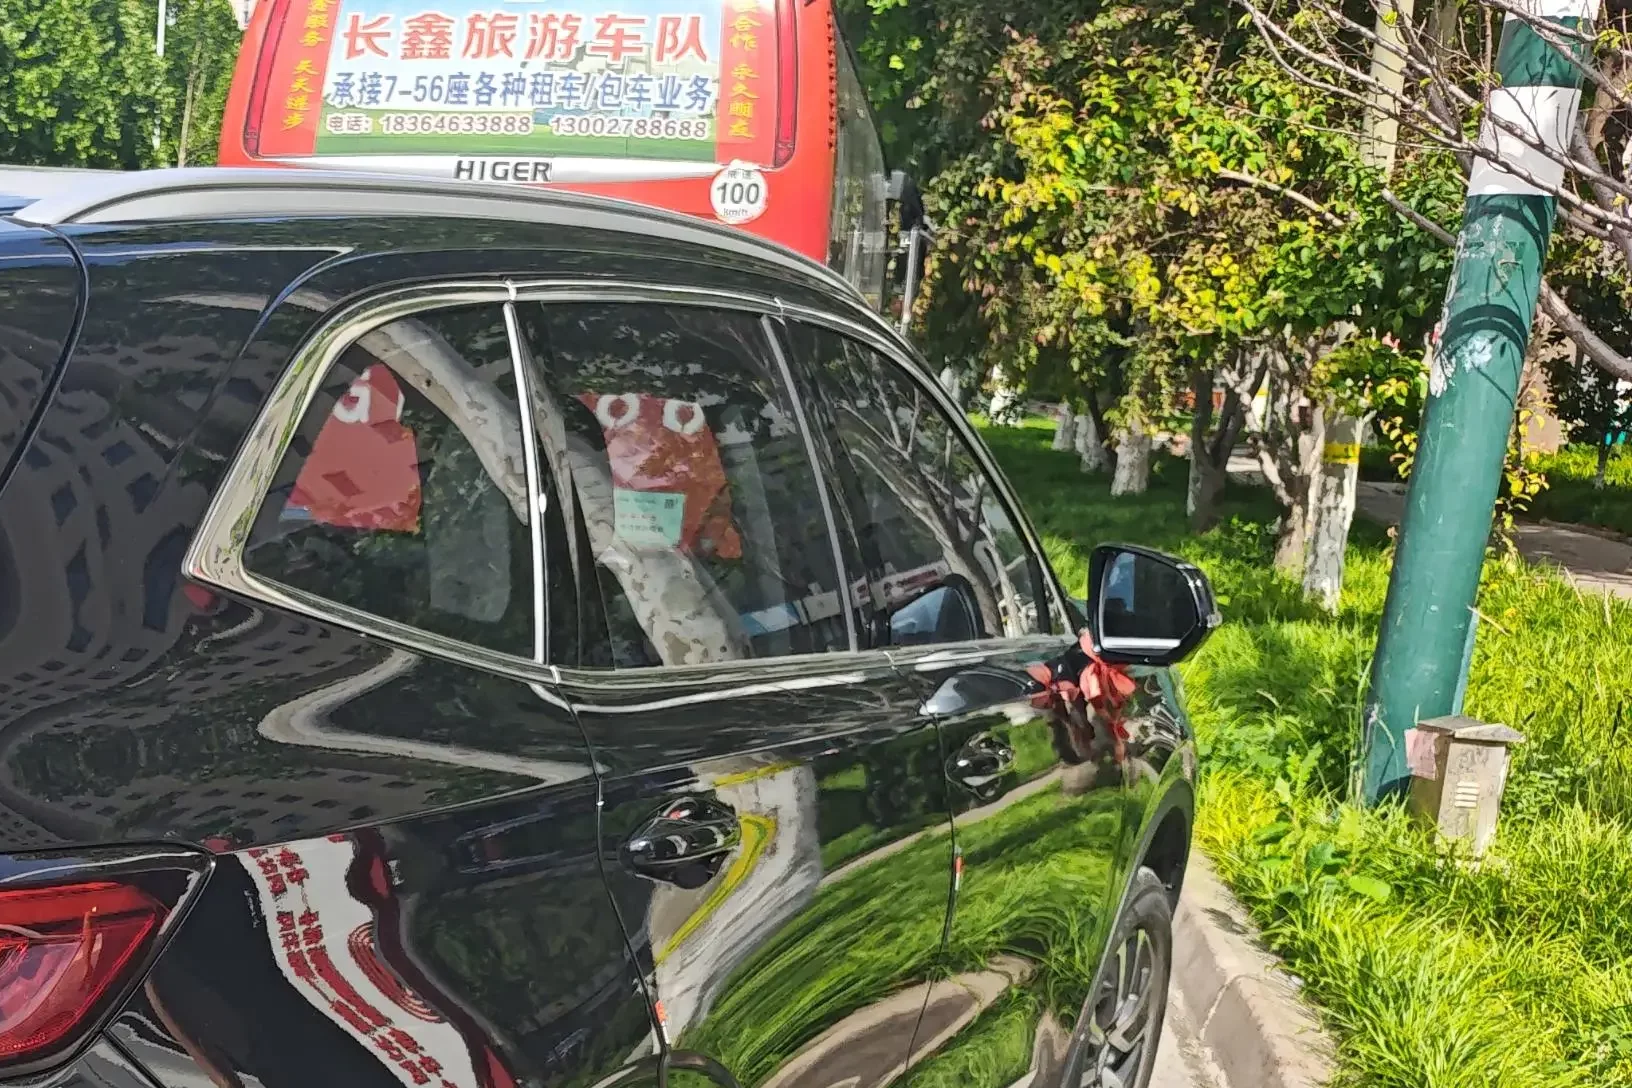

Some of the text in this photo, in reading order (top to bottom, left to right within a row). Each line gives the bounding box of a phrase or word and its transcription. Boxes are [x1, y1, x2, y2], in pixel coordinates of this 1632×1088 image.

[343, 13, 708, 61] 长鑫旅游车队
[381, 115, 531, 134] 18364633888
[551, 116, 707, 138] 13002788688
[453, 160, 551, 182] HIGER
[716, 182, 760, 205] 100
